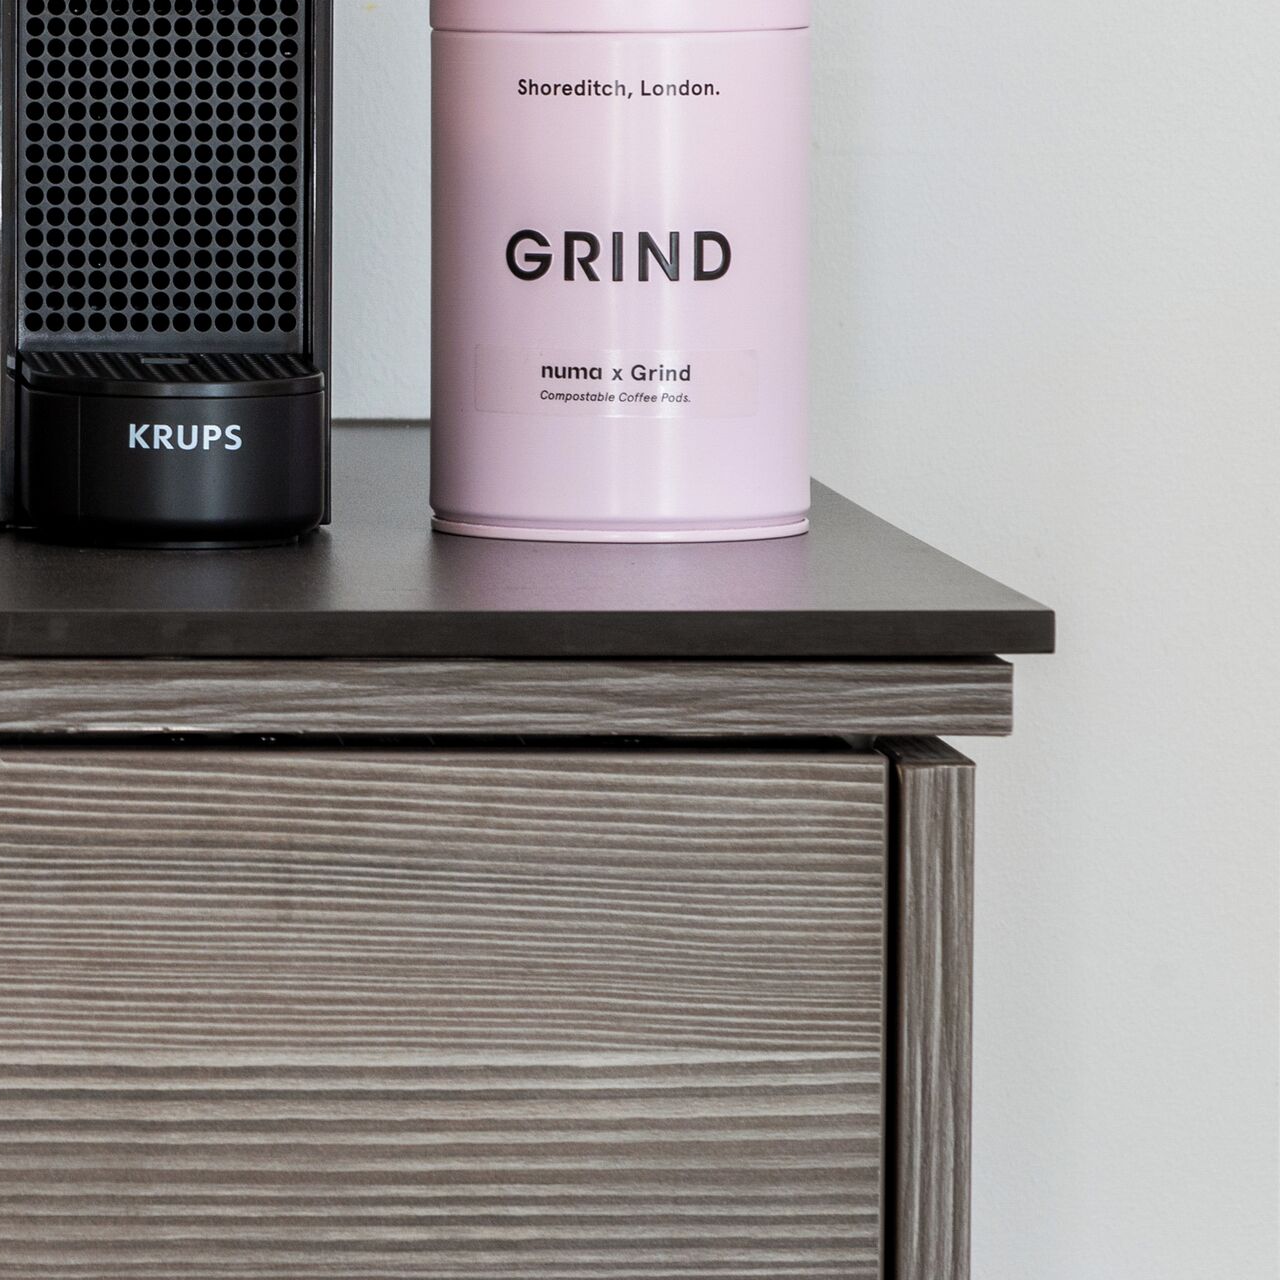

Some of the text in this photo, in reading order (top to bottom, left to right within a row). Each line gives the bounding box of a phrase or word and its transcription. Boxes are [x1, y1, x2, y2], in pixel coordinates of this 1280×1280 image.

[517, 78, 720, 99] Shoreditch, London.
[505, 229, 731, 281] GRIND
[541, 364, 691, 382] numa x Grind
[540, 389, 692, 403] Compostable Coffee Pods.
[129, 423, 242, 451] KRUPS
